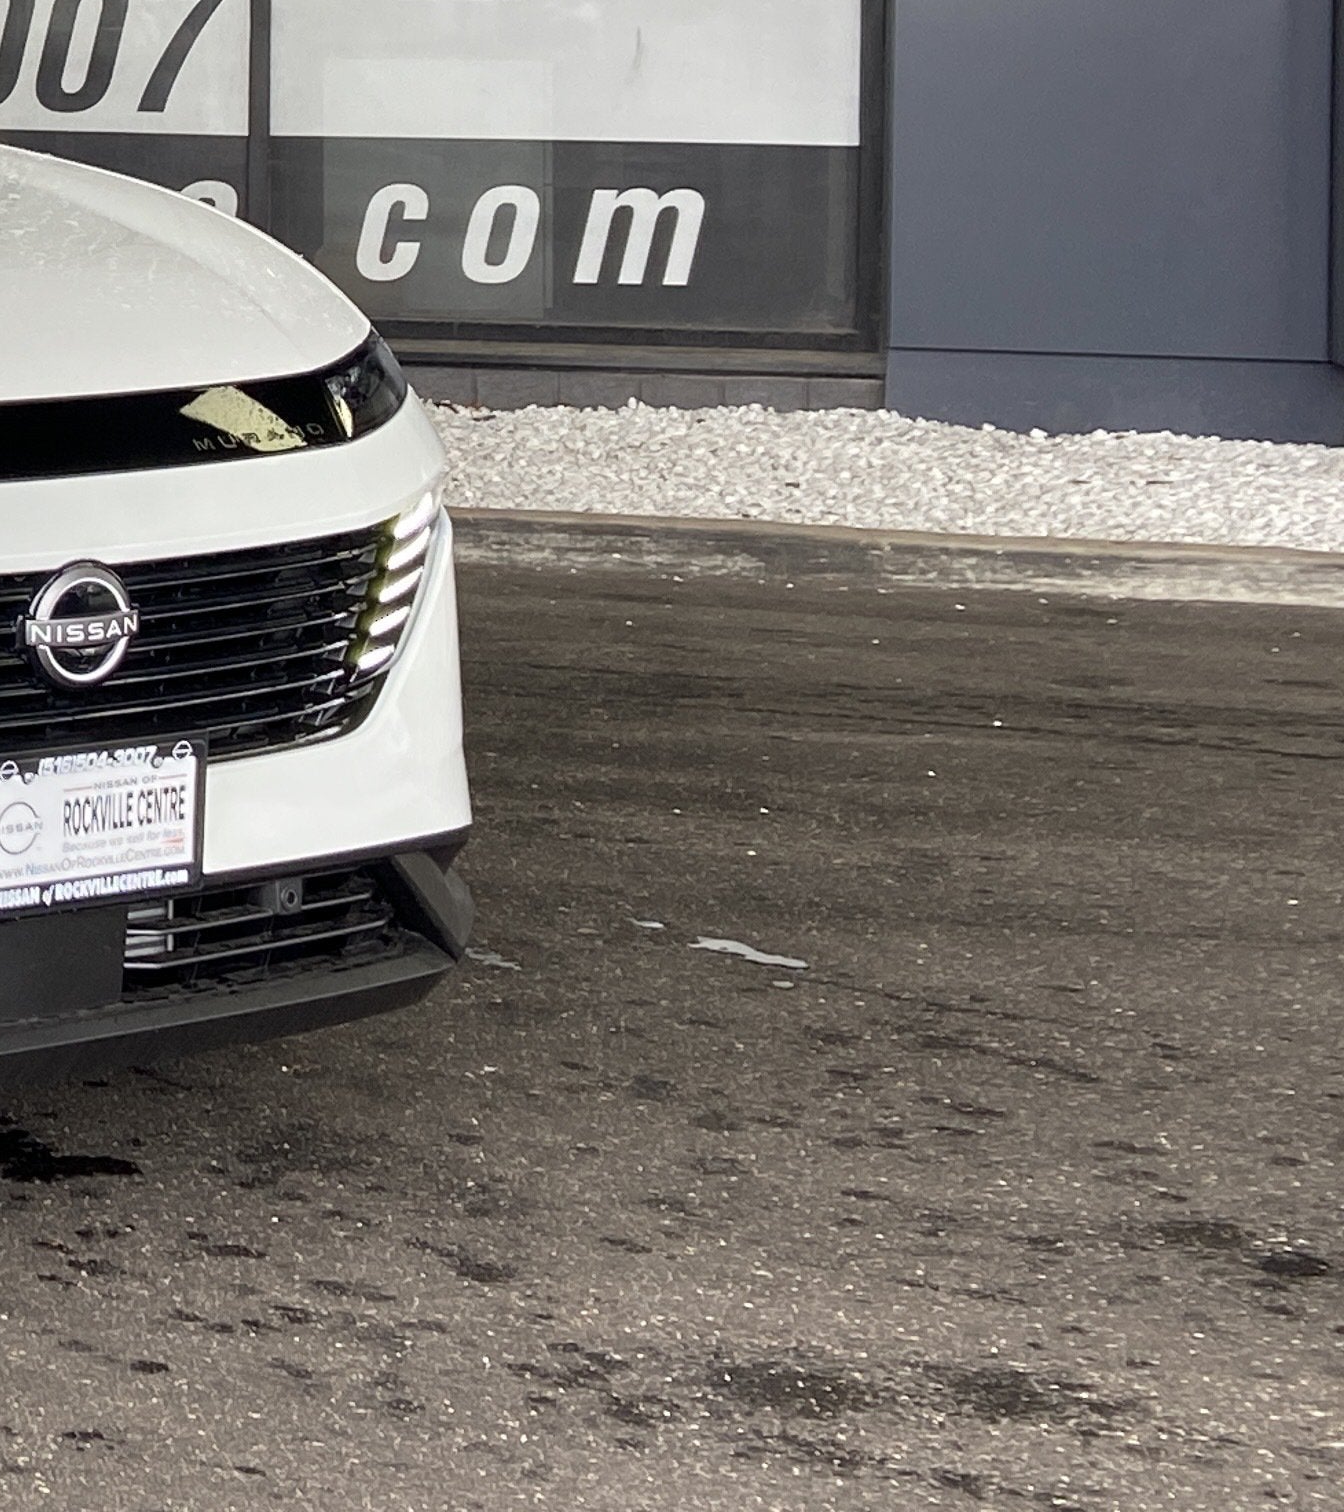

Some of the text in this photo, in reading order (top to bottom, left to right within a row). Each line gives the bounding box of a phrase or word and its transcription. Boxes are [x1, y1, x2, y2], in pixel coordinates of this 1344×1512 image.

[30, 614, 138, 643] NISSAN
[93, 774, 159, 790] NISSAN OF
[63, 785, 186, 837] ROCKVILLE CENTRE
[63, 837, 108, 852] Because
